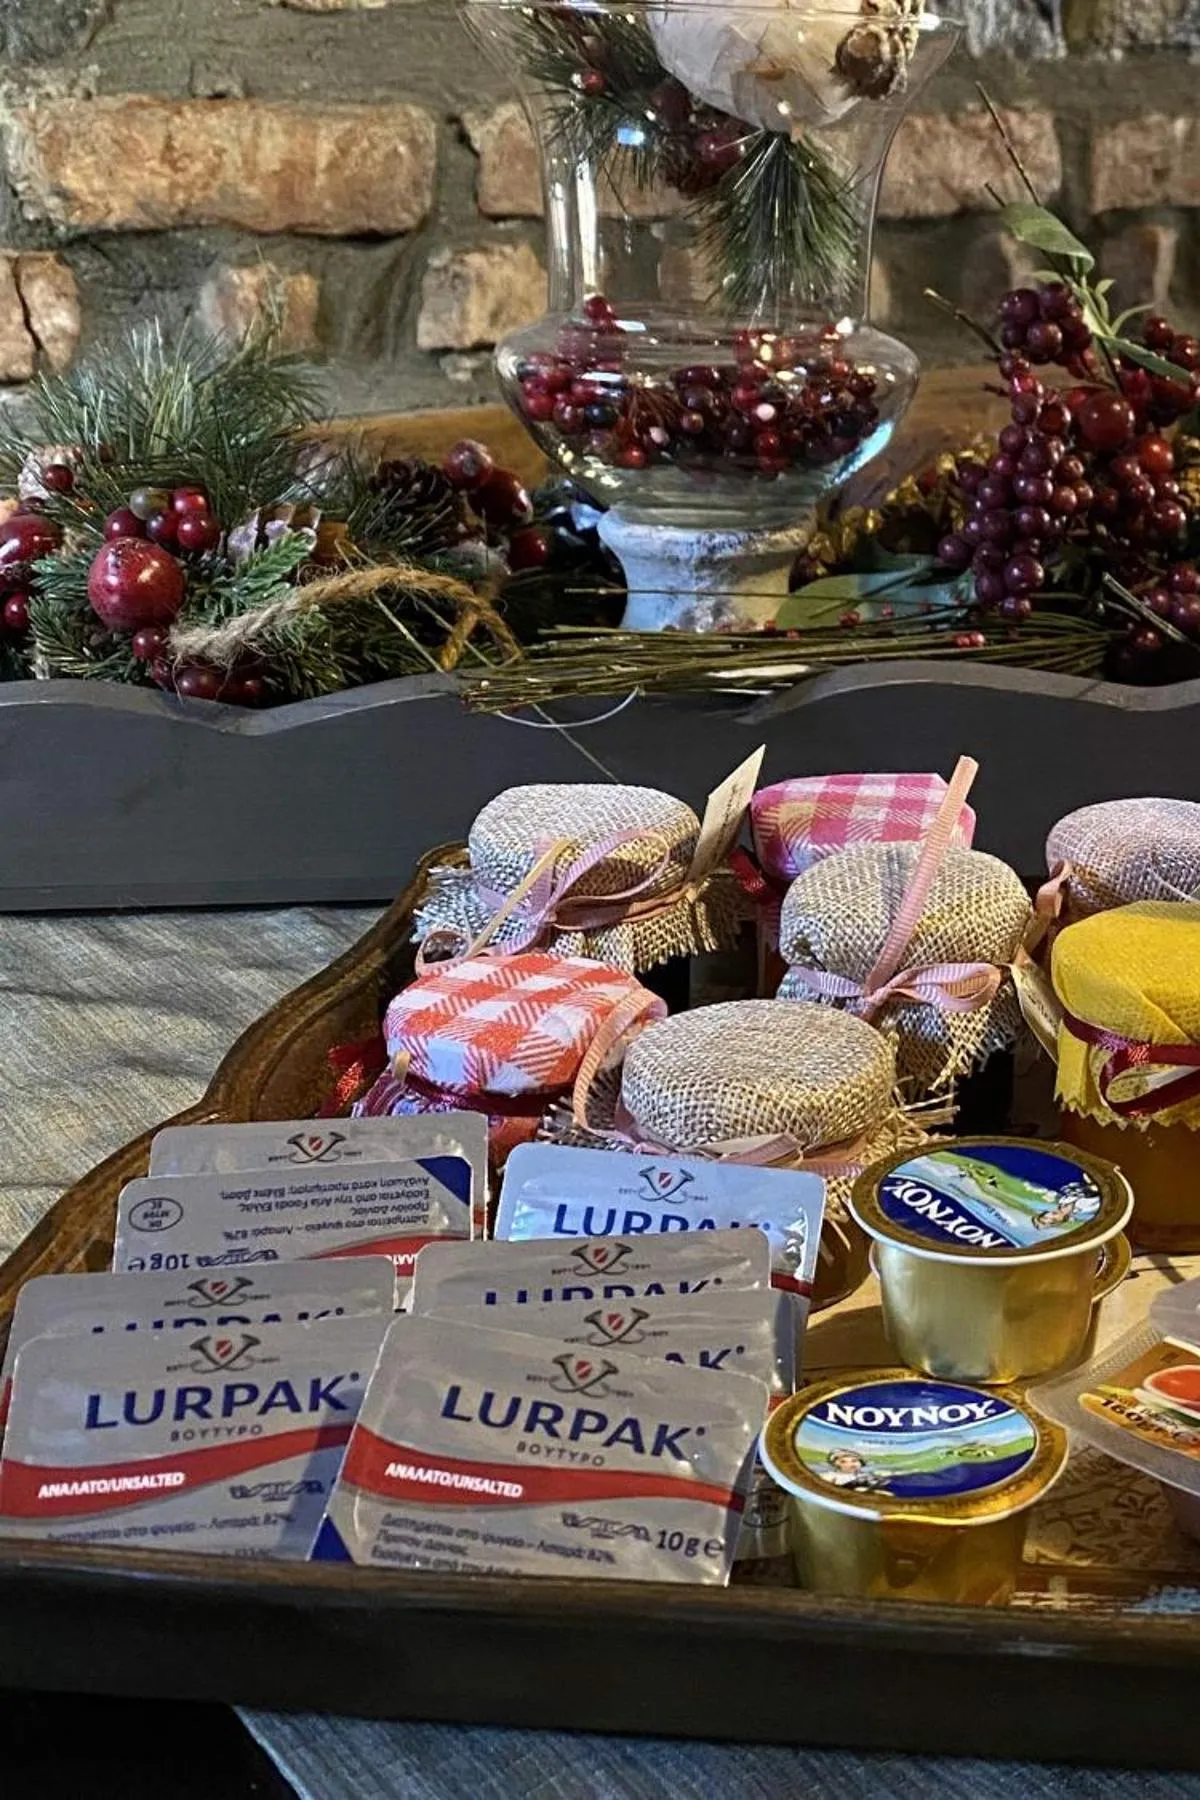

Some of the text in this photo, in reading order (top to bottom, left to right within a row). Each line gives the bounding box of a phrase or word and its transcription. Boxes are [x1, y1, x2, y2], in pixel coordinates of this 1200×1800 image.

[273, 1199, 308, 1212] Foods
[333, 1193, 354, 1205] την
[354, 1191, 378, 1203] από
[881, 1180, 1008, 1250] NOYNOY
[84, 1374, 350, 1430] LURPAK
[826, 1398, 995, 1428] NOYNOY
[170, 1424, 264, 1443] ΒΟΥΤΥΡΟ
[440, 1384, 692, 1462] LURPAK
[515, 1439, 607, 1468] ΒΟΥΤΥΡΟ
[38, 1471, 186, 1500] ΑΝΑΛΑΤΟ/UNSALTED
[384, 1462, 524, 1499] ΑΝΑΛΑΤΟ/UNSALTED
